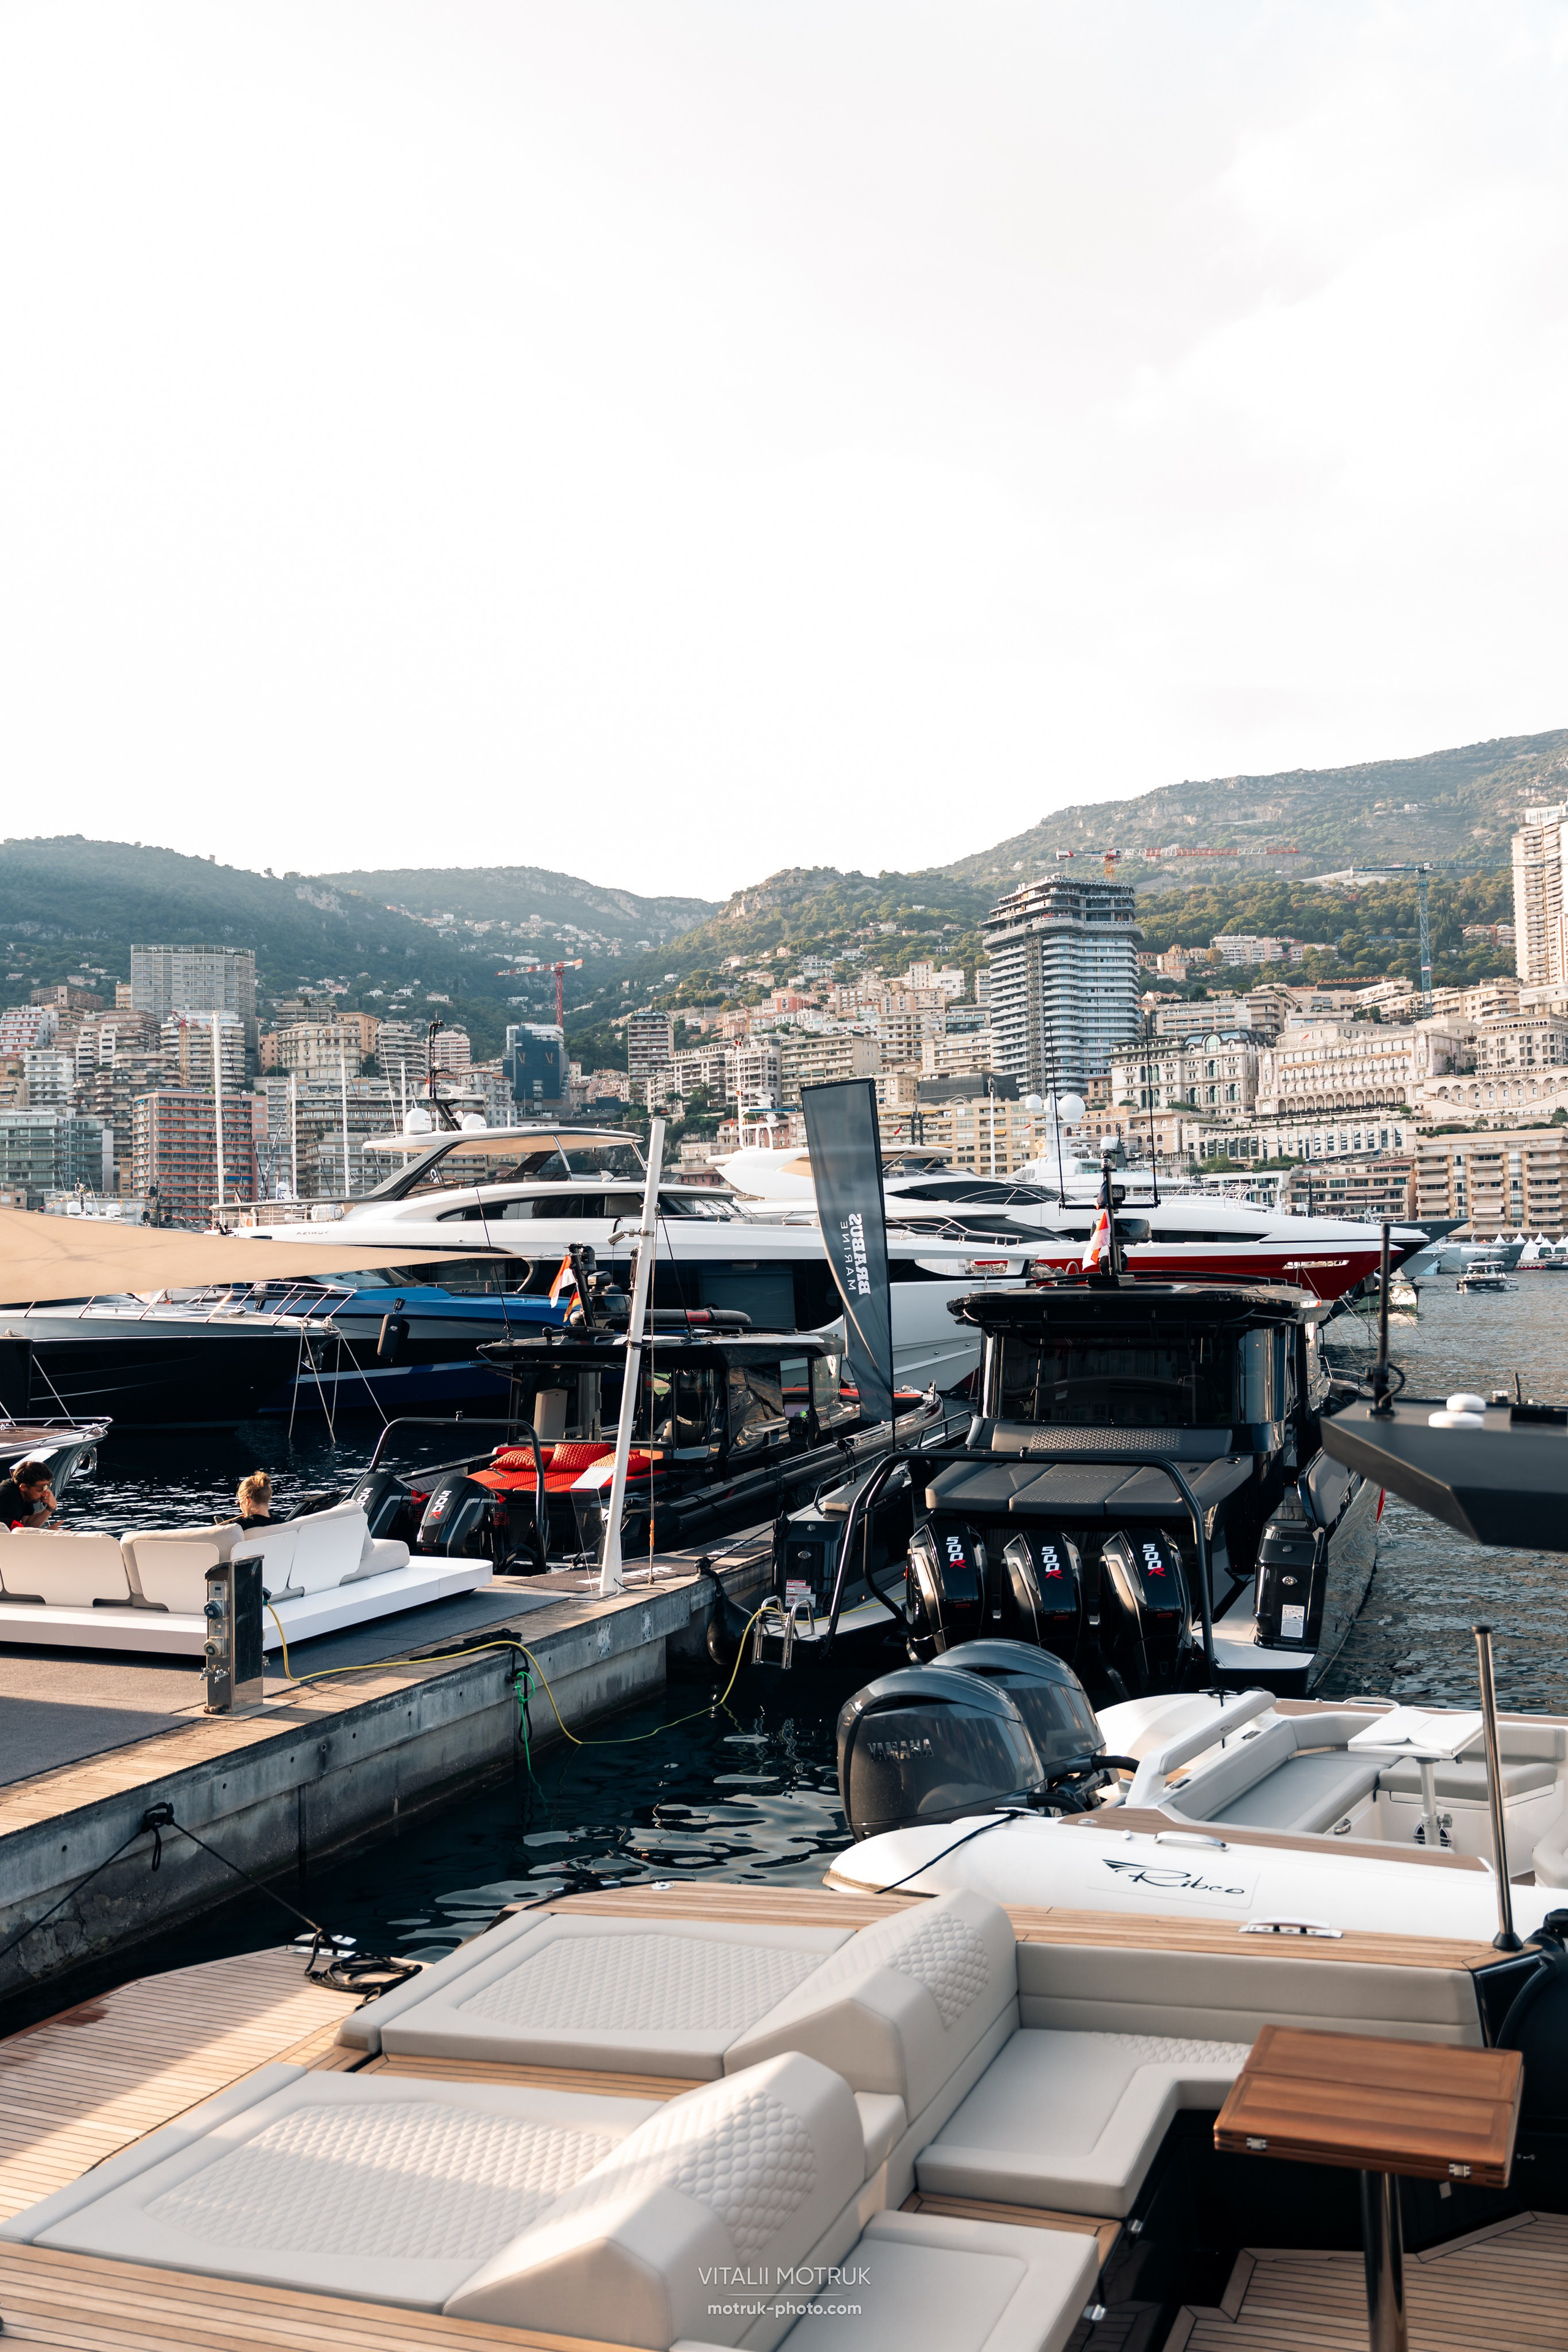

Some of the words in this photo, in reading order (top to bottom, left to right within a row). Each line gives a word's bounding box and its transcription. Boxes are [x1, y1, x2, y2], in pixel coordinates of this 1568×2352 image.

[946, 1536, 967, 1568] 500R
[1041, 1546, 1063, 1579] 500R
[1142, 1544, 1166, 1577] 500R
[867, 1739, 933, 1762] YAMAHA
[1114, 1867, 1245, 1894] Ribco
